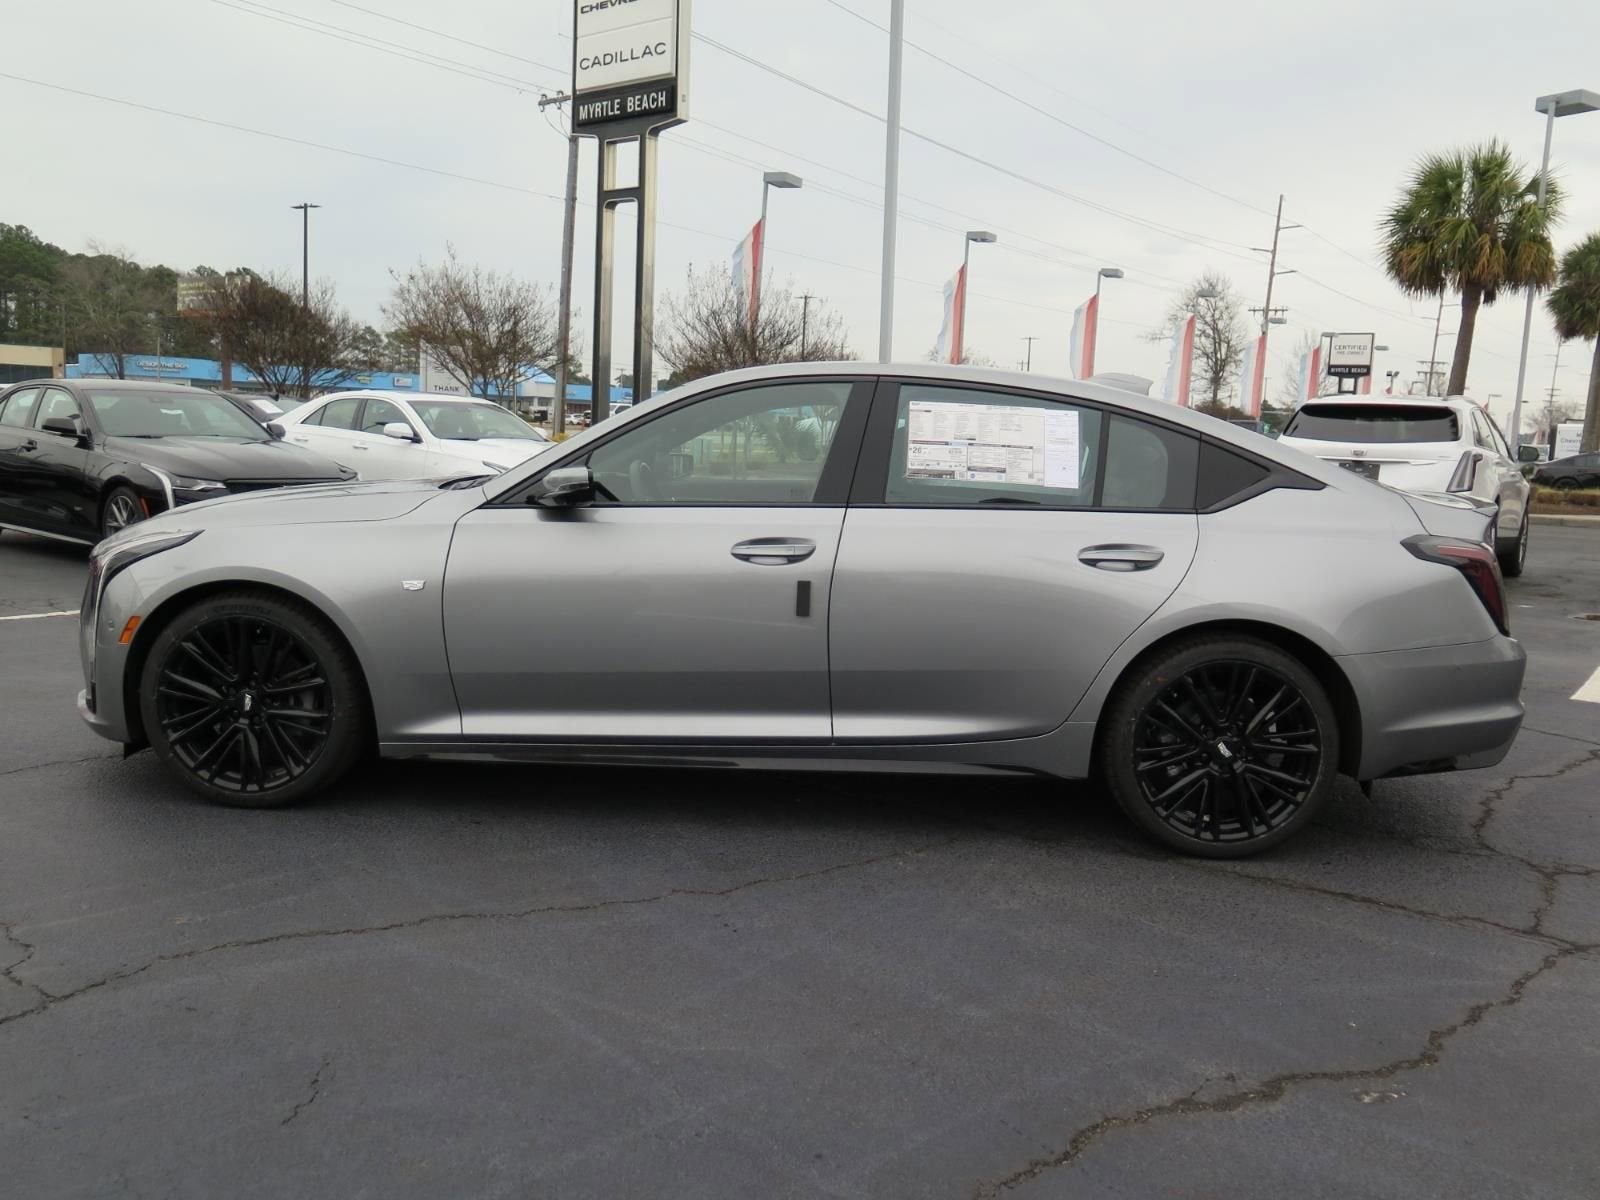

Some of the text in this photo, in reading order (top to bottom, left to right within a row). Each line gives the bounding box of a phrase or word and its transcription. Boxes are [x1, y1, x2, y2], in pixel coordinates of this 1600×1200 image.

[579, 42, 667, 70] CADILLAC
[579, 90, 666, 121] MYRTLE BEACH
[433, 384, 460, 392] THANK
